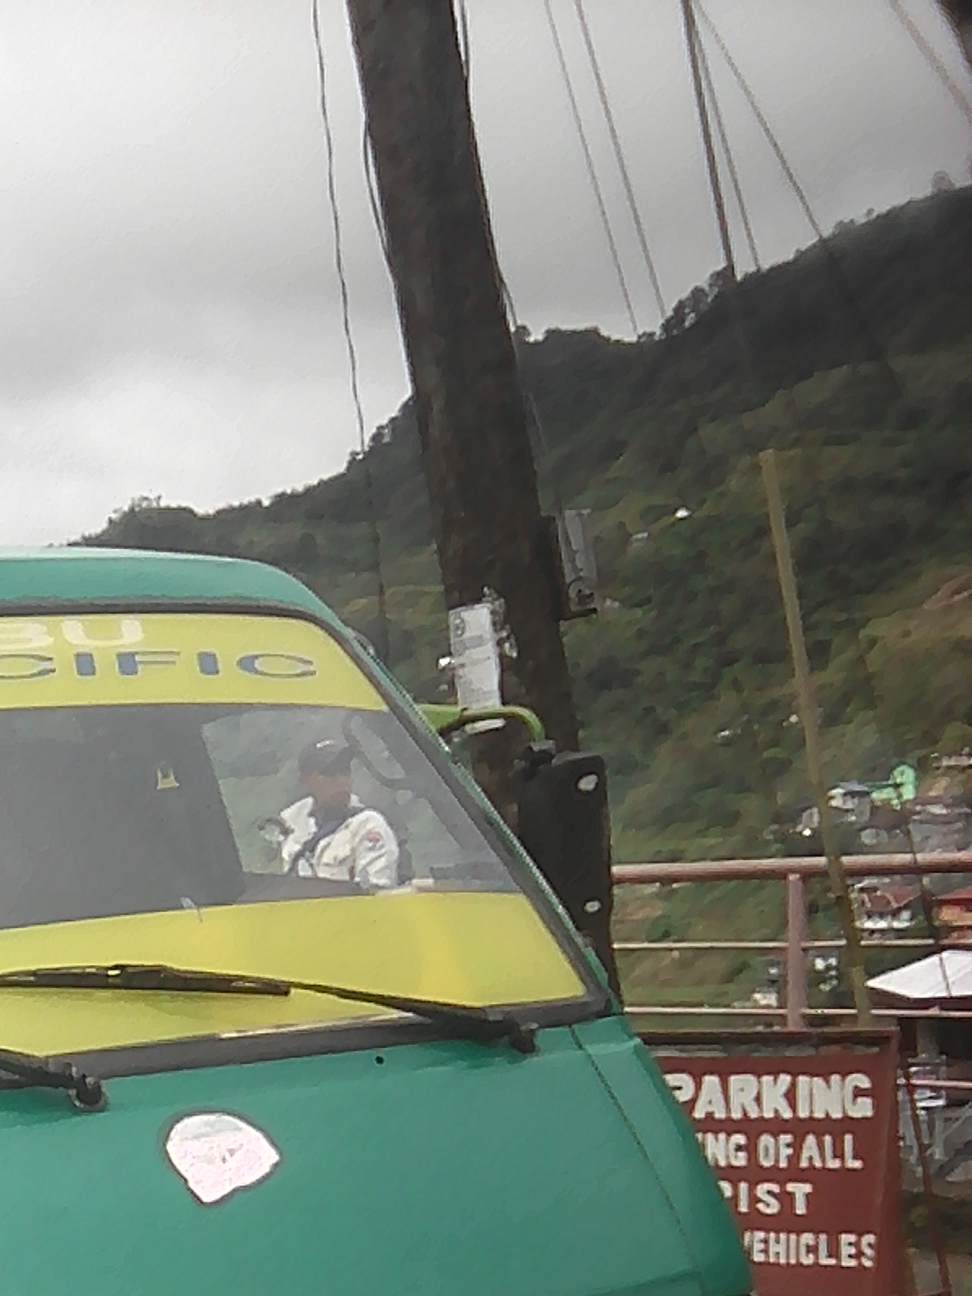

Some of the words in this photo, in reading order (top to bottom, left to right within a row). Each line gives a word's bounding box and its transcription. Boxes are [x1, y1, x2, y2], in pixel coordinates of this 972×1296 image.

[662, 1072, 876, 1120] PARKING
[757, 1132, 794, 1169] OF
[799, 1132, 865, 1170] ALL
